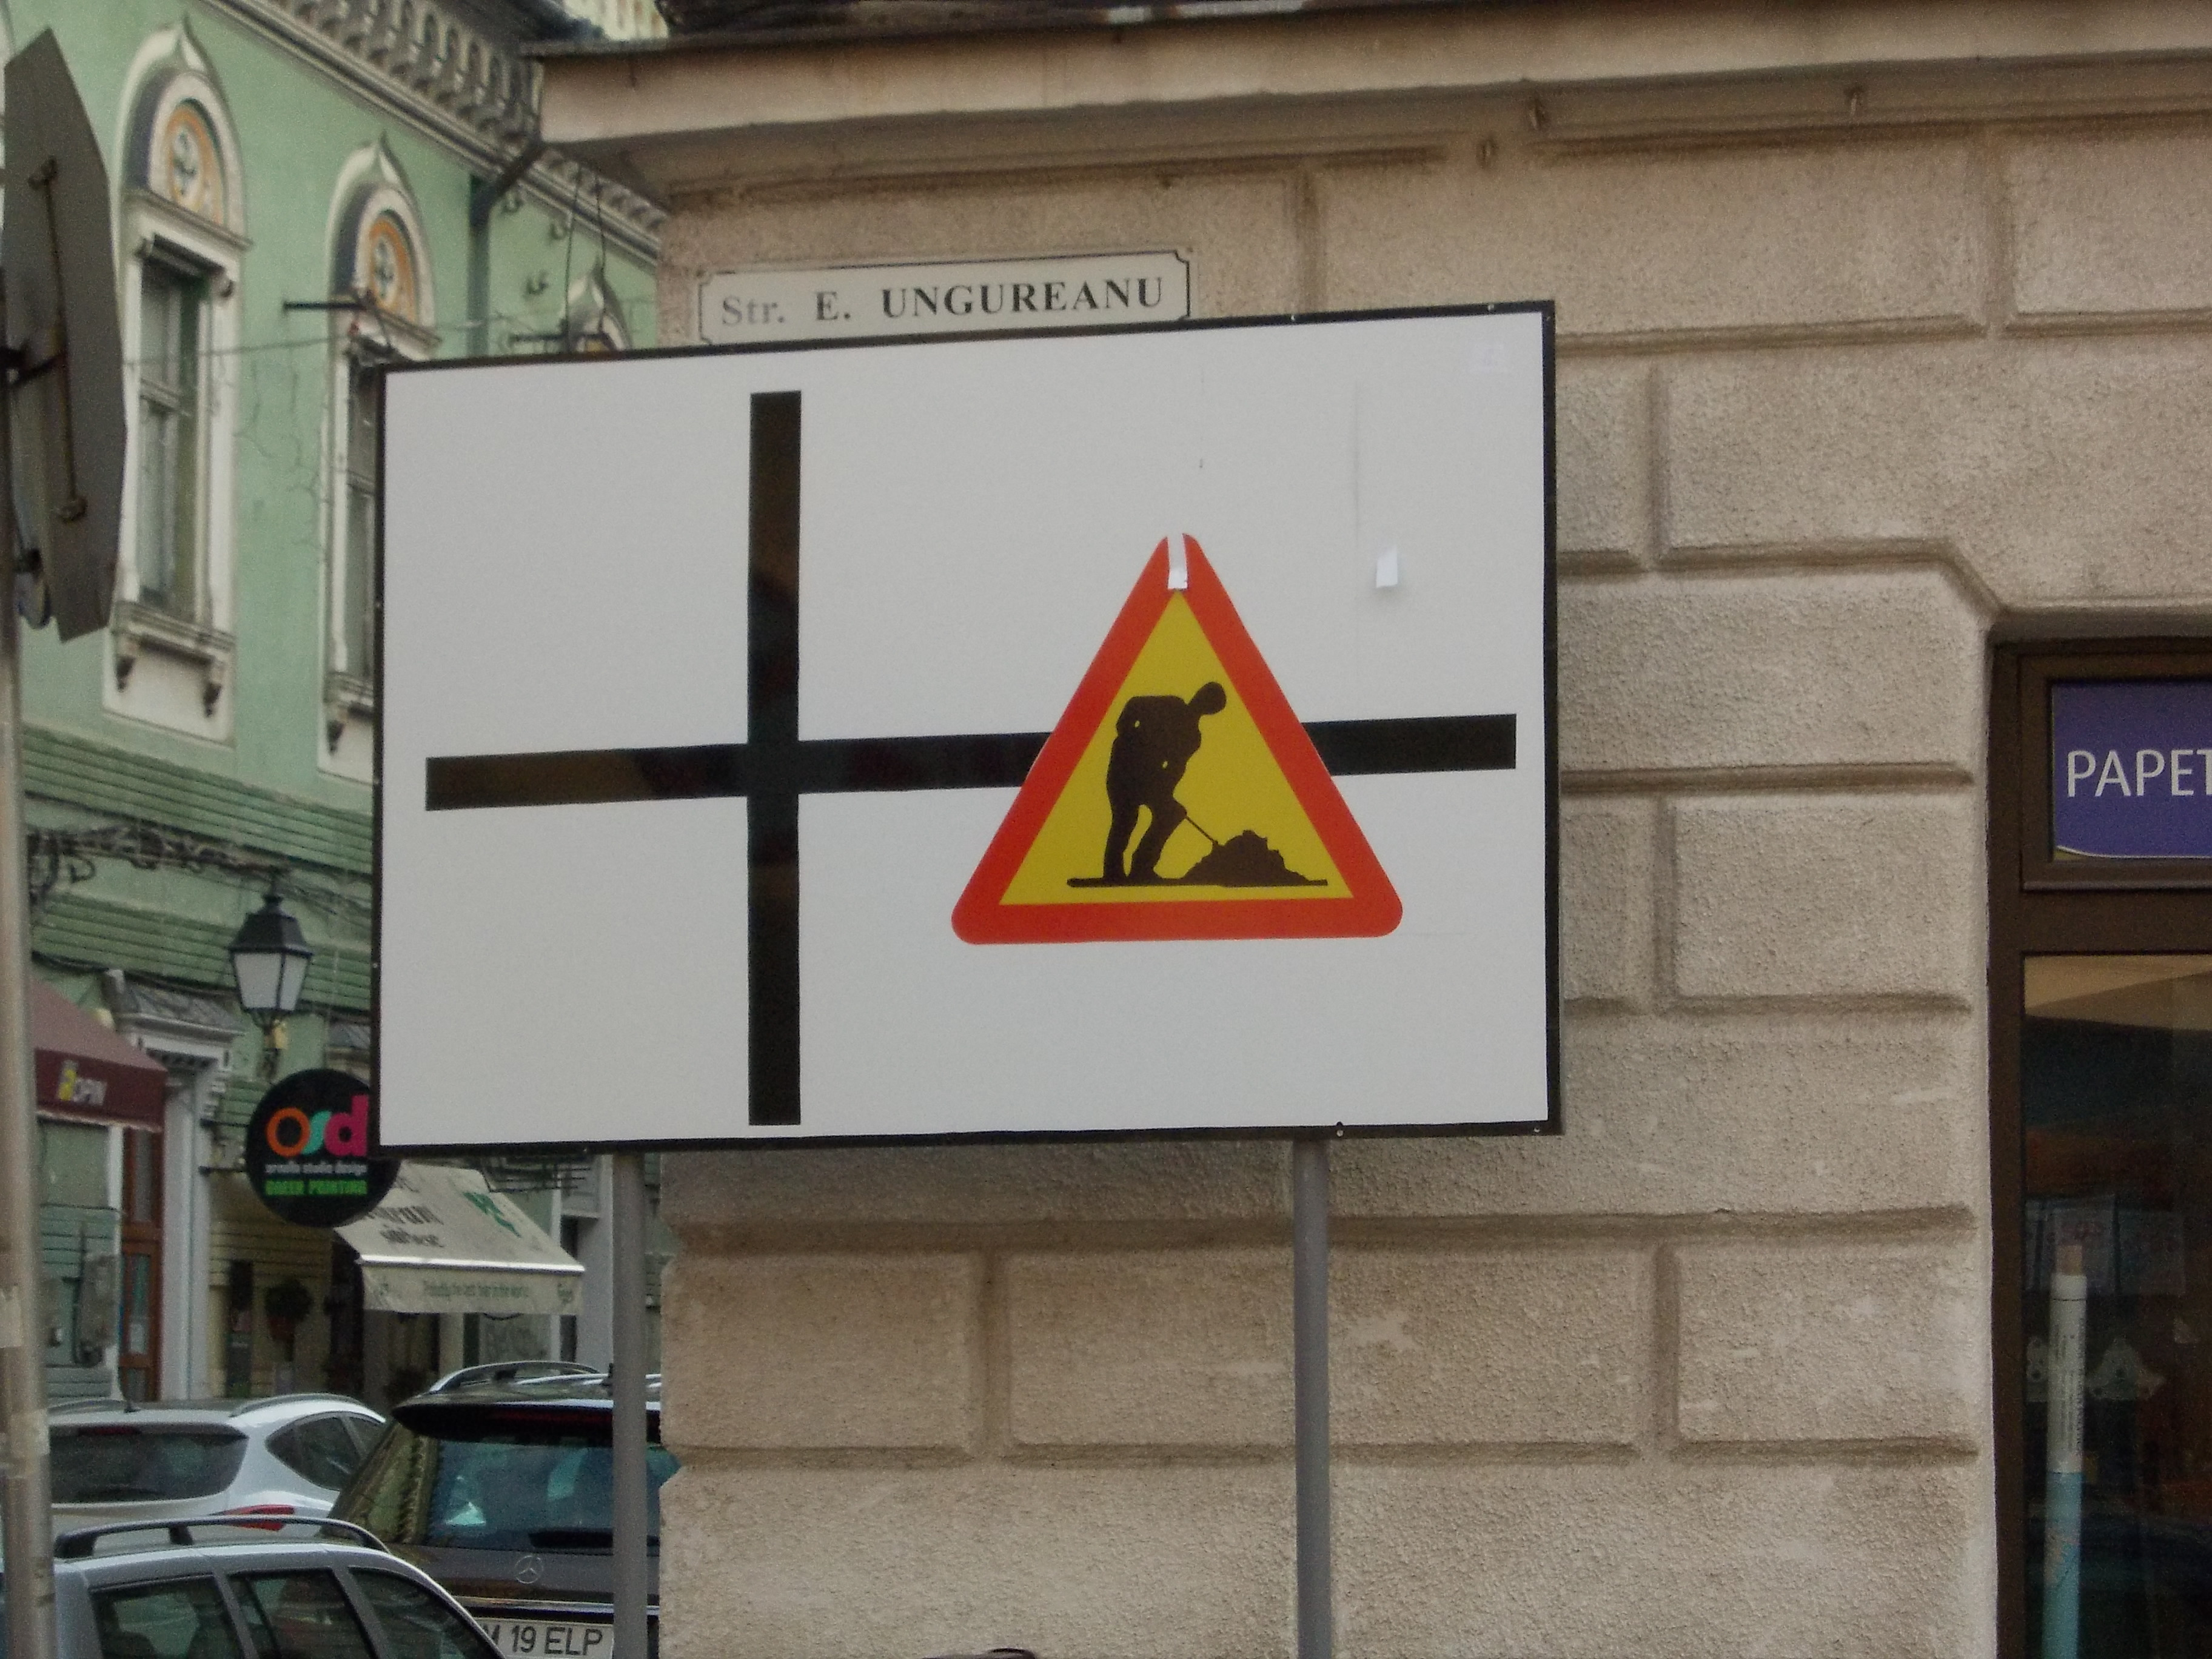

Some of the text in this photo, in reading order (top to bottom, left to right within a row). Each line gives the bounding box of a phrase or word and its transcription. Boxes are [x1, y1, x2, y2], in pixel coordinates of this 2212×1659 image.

[722, 276, 1163, 326] Str. E. UNGUREANU
[2066, 748, 2212, 797] PAPET
[511, 1624, 537, 1654] 19
[544, 1626, 603, 1656] ELP
